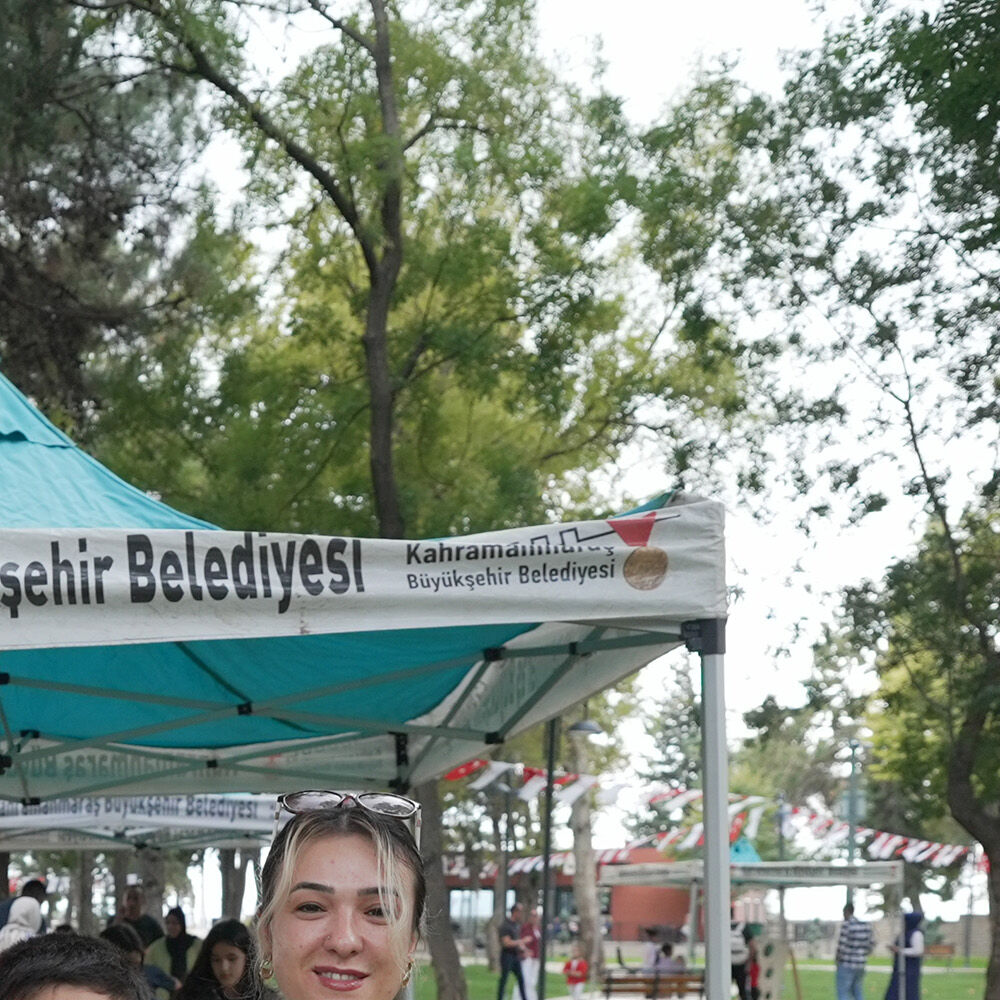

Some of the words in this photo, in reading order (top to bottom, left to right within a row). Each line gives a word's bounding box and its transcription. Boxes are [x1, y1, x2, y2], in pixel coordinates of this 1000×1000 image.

[406, 542, 615, 566] Kahramanm
[126, 531, 365, 614] Belediyesi
[406, 566, 512, 593] Büyükşehir
[519, 559, 616, 586] Belediyesi
